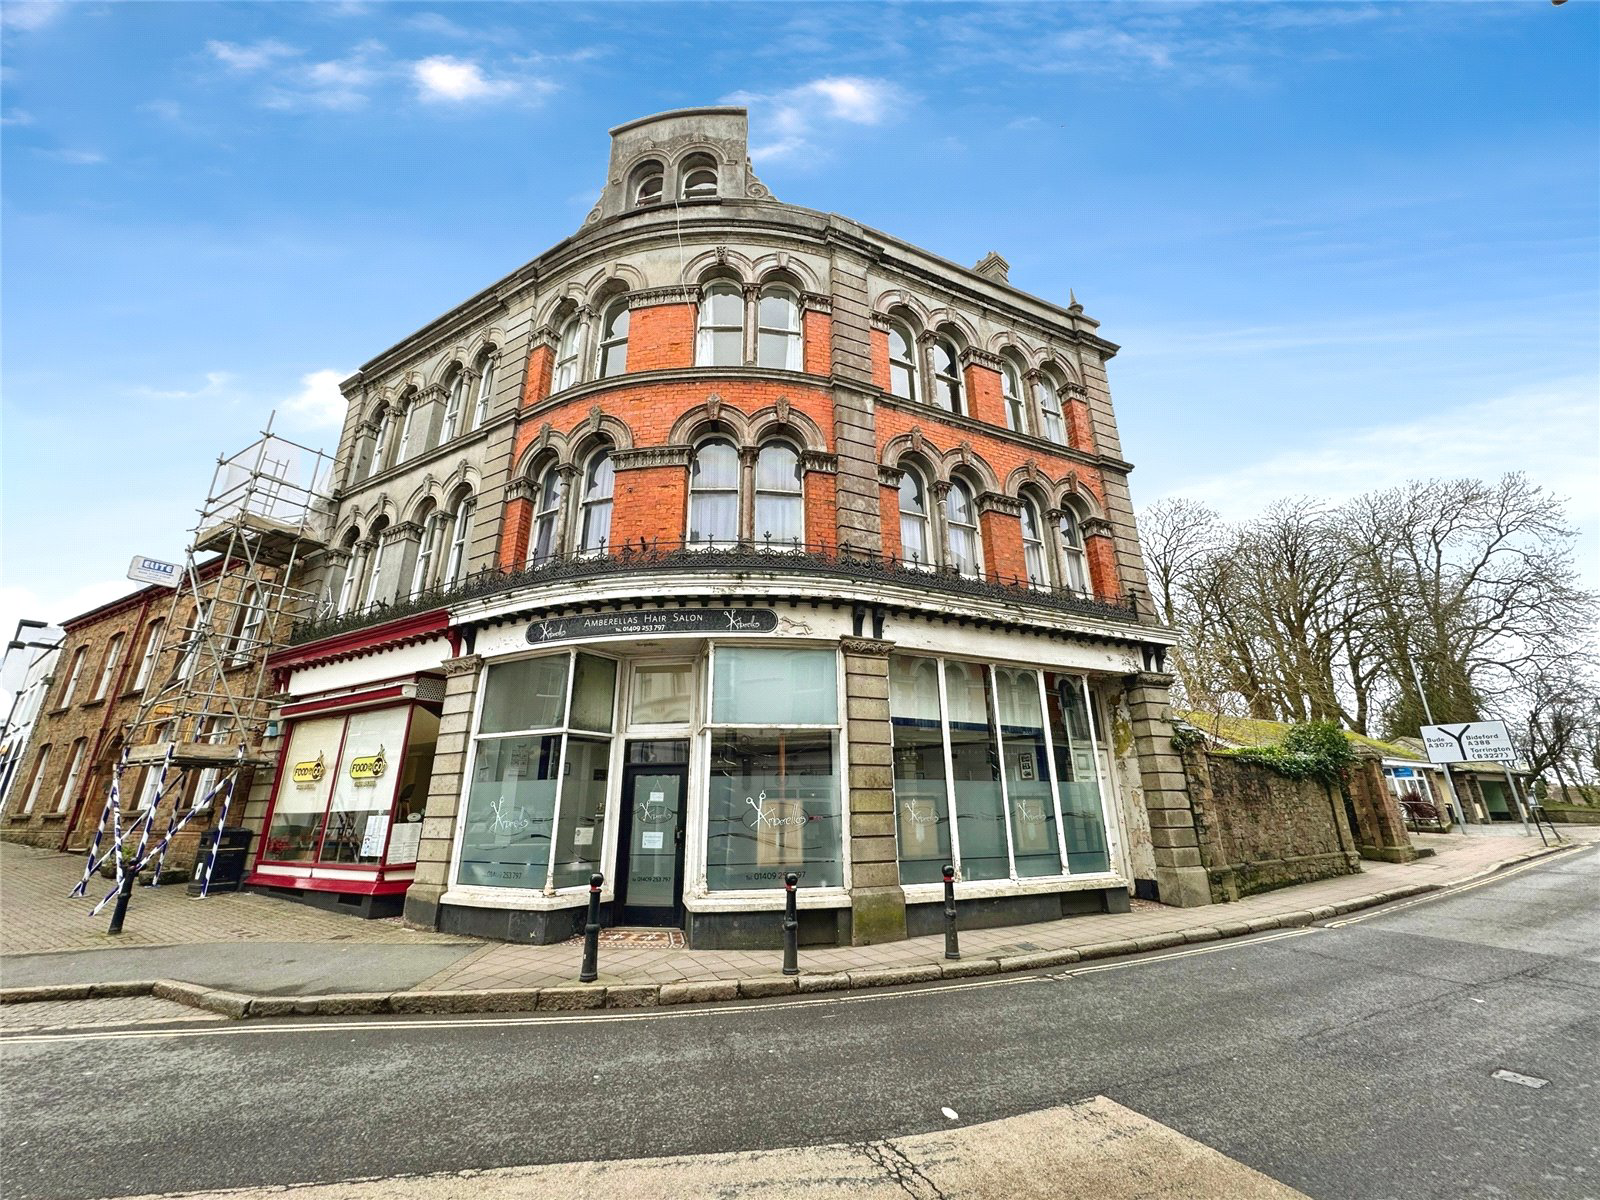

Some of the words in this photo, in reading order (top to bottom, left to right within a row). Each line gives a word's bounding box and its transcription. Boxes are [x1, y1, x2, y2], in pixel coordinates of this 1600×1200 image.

[143, 560, 173, 573] ELITE
[583, 616, 638, 628] AMBERELLAS
[644, 614, 667, 623] HAIR
[673, 612, 703, 622] SALON
[352, 763, 368, 773] FOOD
[754, 872, 776, 880] 01409
